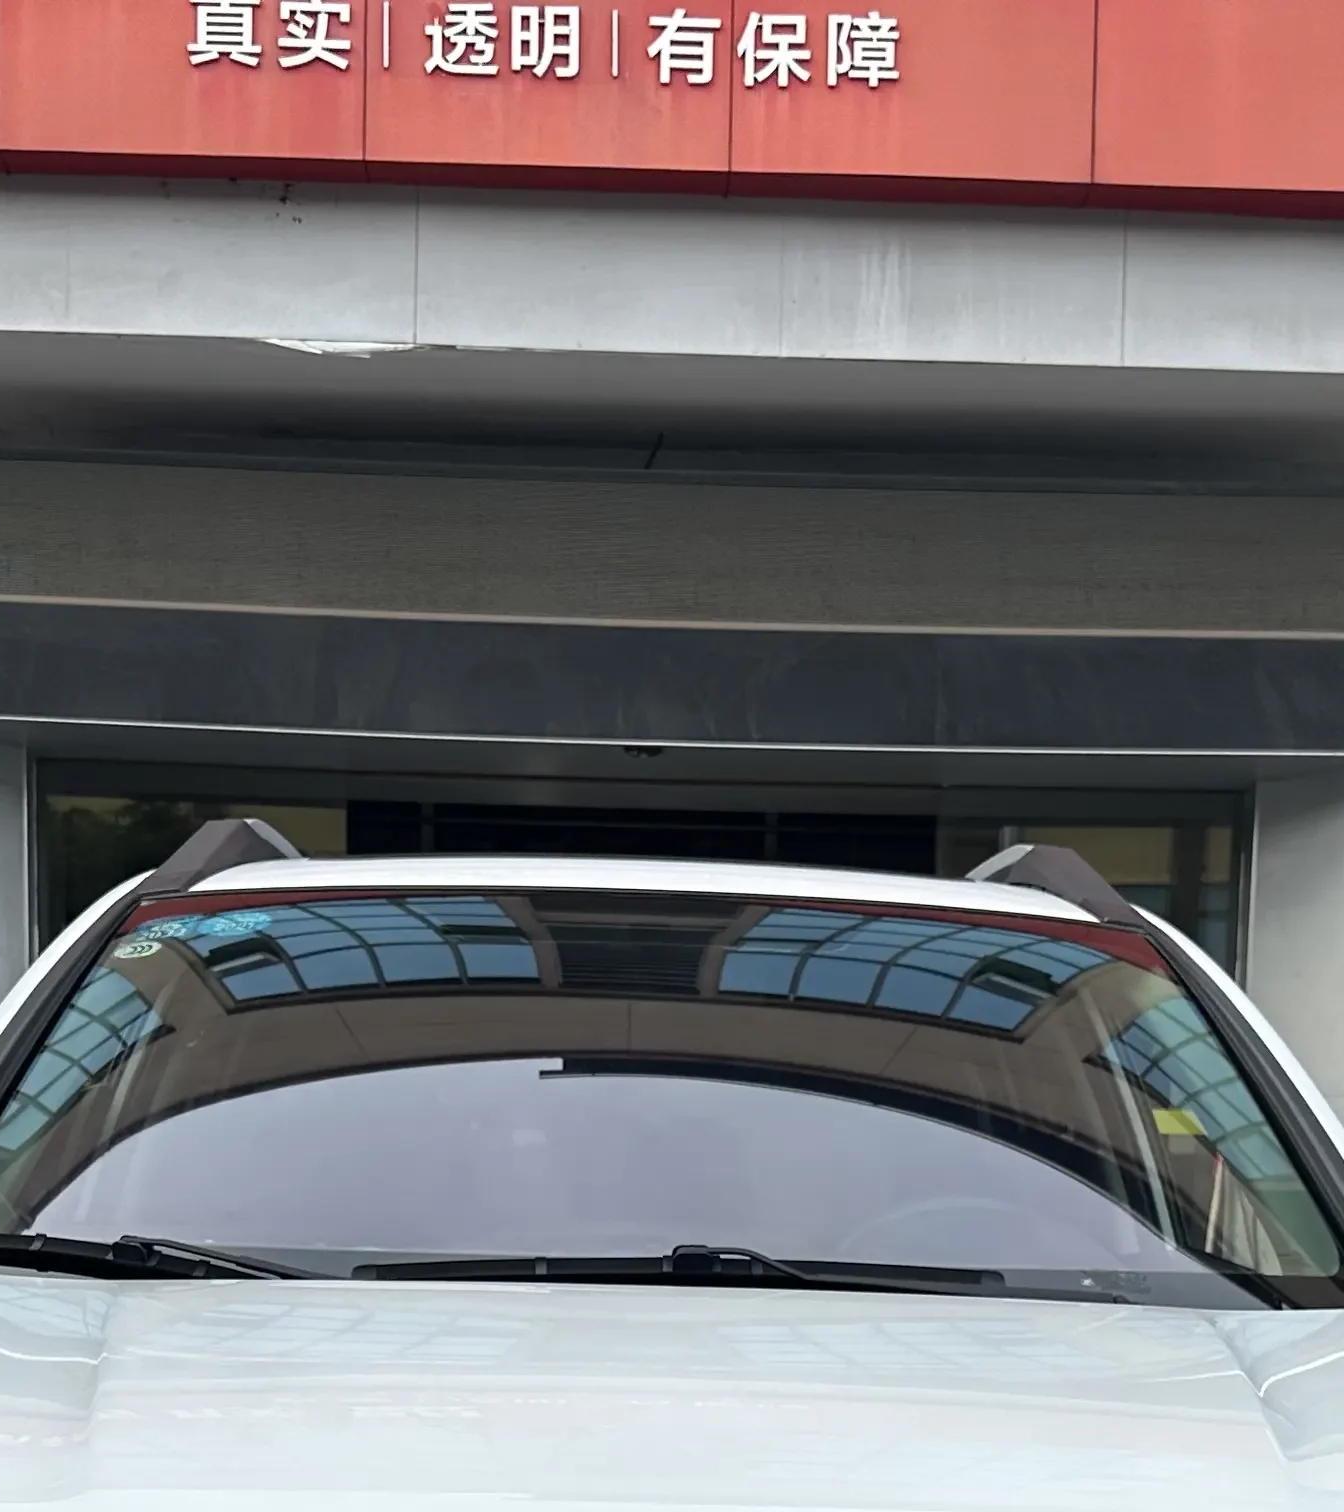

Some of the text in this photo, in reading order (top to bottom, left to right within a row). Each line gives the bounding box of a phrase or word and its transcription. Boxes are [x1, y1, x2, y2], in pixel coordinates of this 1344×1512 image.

[186, 0, 901, 87] 真实 透明 有保障
